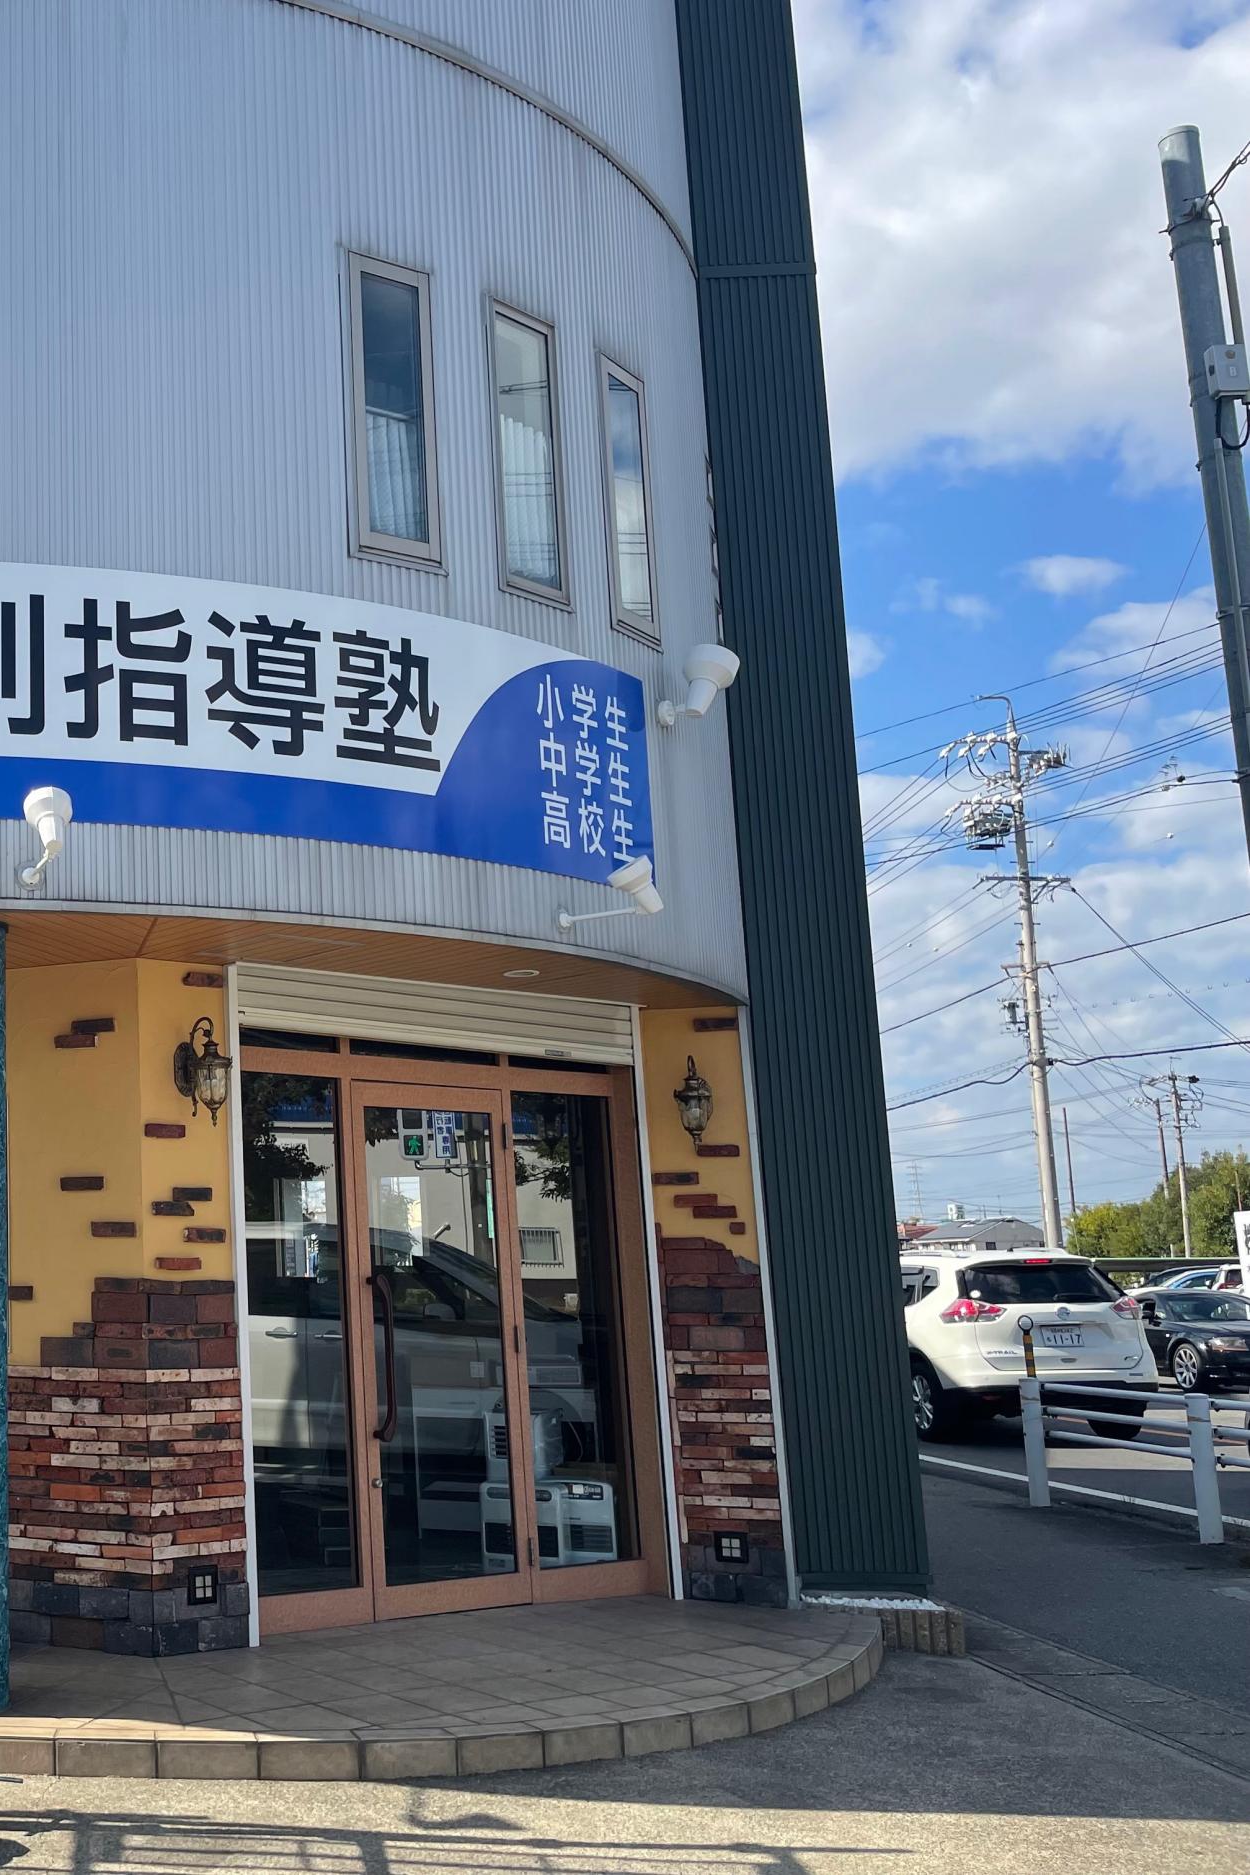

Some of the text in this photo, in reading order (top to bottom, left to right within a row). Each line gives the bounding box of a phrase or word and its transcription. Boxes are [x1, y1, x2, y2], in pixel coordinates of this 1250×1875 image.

[536, 673, 629, 751] 小学生
[539, 731, 633, 807] 中学生
[541, 790, 636, 863] 高校生
